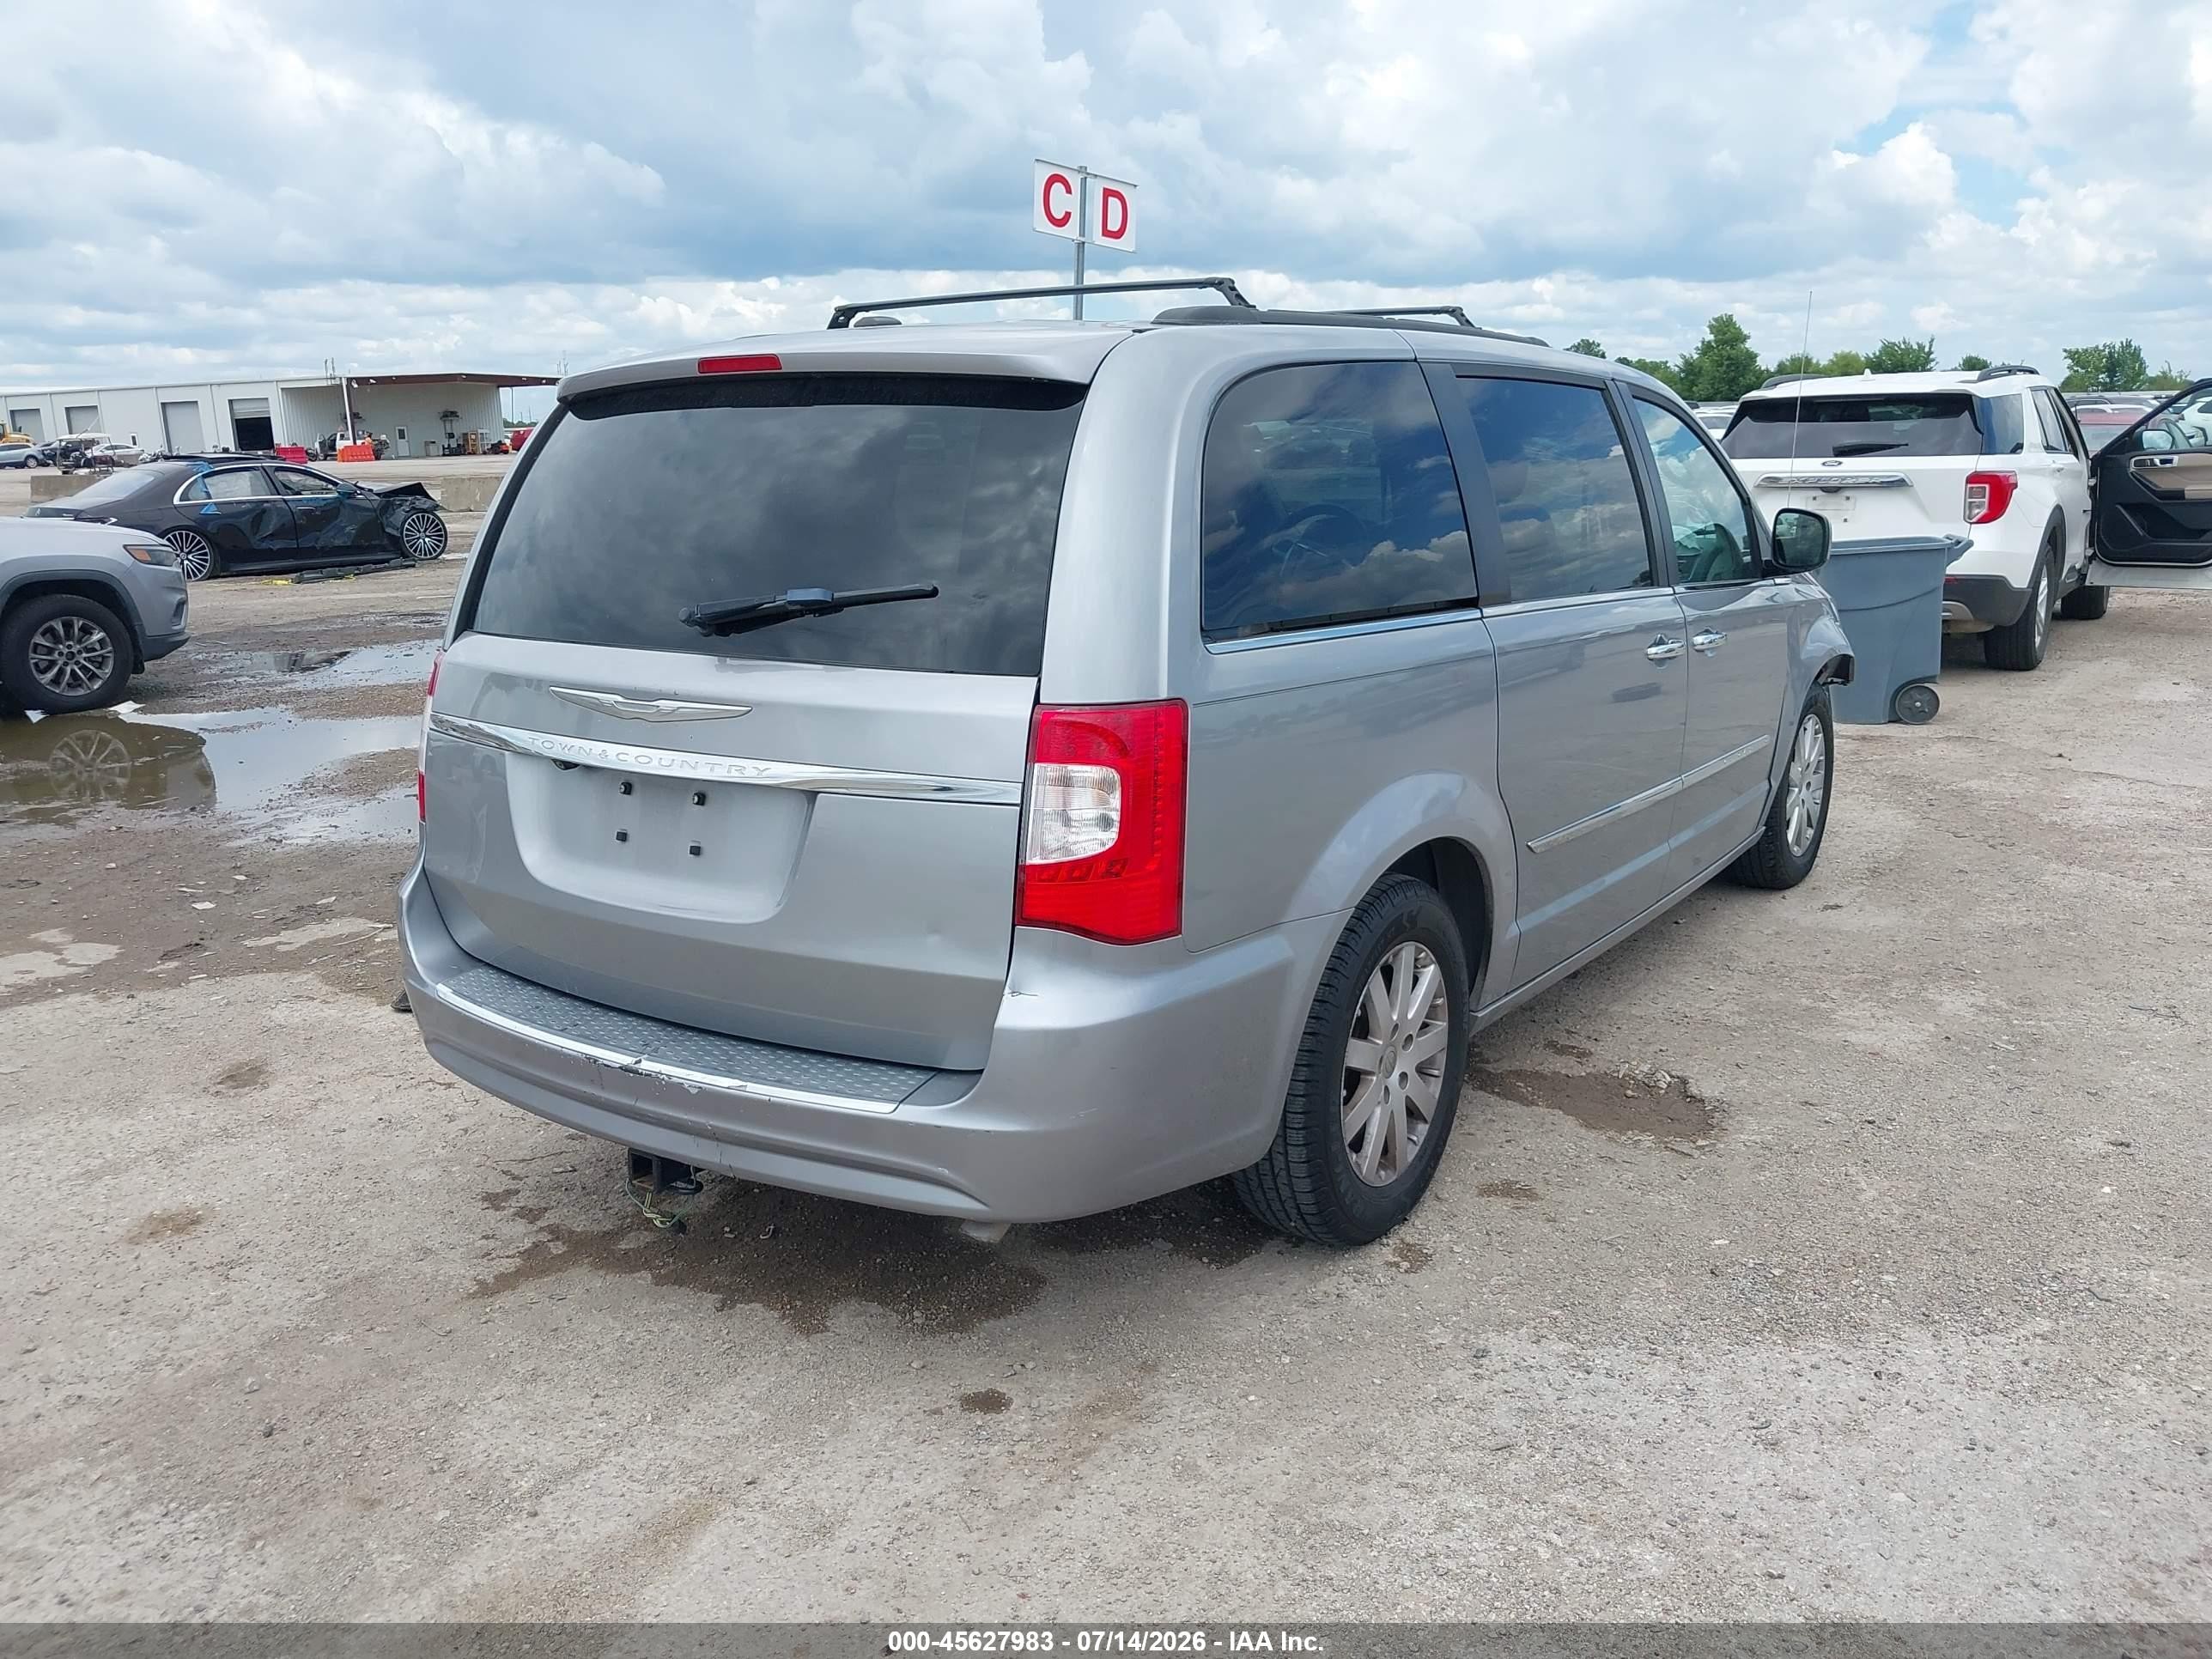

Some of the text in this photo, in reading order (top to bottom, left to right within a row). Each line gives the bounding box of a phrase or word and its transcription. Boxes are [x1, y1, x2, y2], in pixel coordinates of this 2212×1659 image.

[1043, 173, 1072, 228] C
[1102, 187, 1128, 240] D
[1778, 476, 1882, 484] EXPLORER
